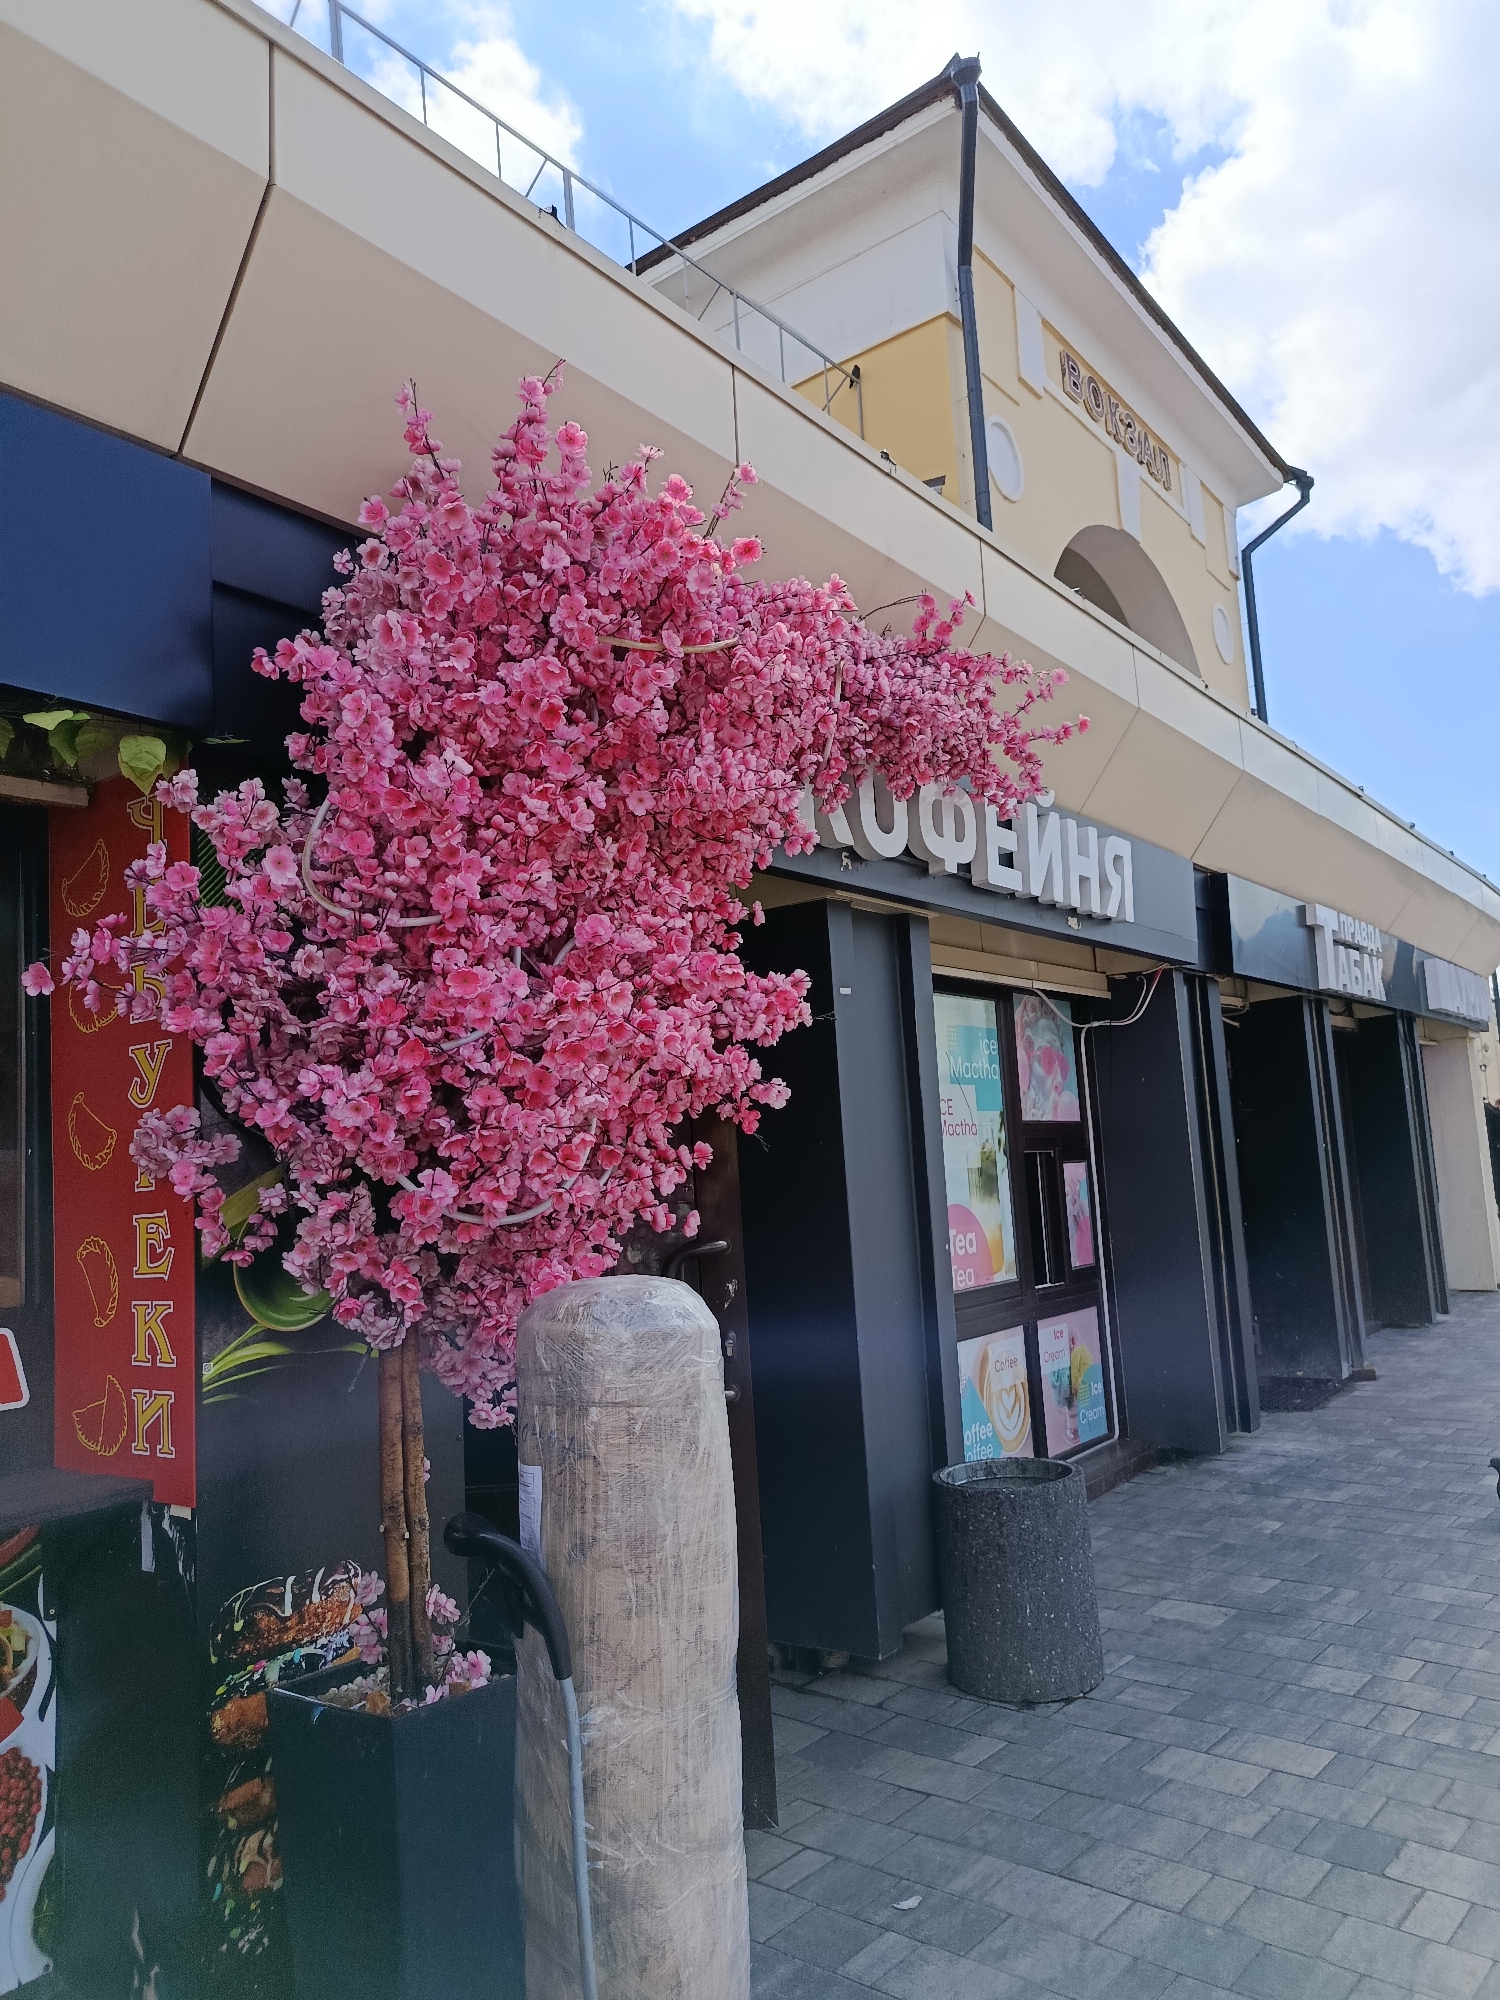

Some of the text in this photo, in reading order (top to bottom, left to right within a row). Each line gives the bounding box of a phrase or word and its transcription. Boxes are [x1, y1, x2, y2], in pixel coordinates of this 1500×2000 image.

[1060, 349, 1173, 491] ВОКЗАЛ
[798, 764, 1135, 923] КОФЕЙНЯ
[1338, 913, 1382, 955] ПРАВДА
[1307, 903, 1387, 1002] ТАБАК
[979, 1032, 998, 1055] ice
[949, 1055, 999, 1081] Mactha
[940, 1099, 954, 1116] CE
[127, 794, 177, 1459] ЧБУЕКИ
[949, 1229, 977, 1257] Tea
[952, 1265, 975, 1289] Tea
[1053, 1328, 1064, 1340] Ice
[994, 1356, 1019, 1373] Coffee
[1043, 1348, 1067, 1364] Cream
[1091, 1381, 1103, 1396] Ice
[1079, 1405, 1105, 1425] Cream
[963, 1421, 993, 1445] offee
[964, 1443, 994, 1461] offee
